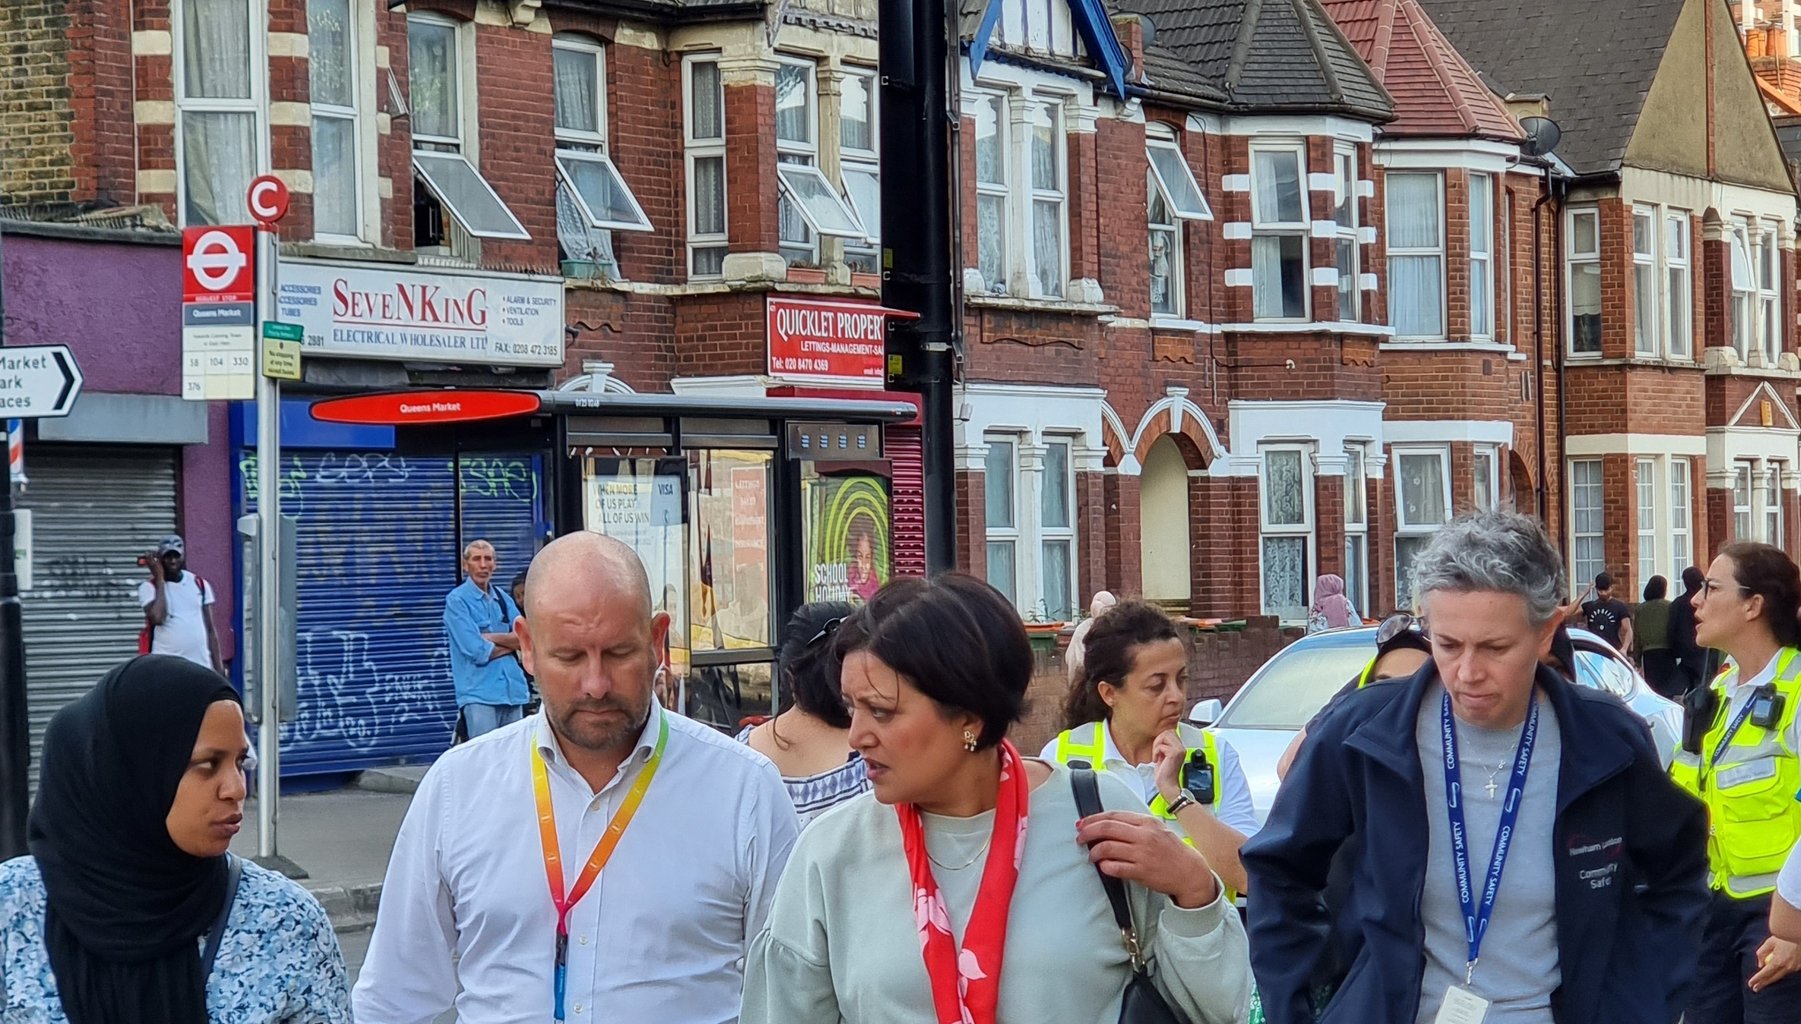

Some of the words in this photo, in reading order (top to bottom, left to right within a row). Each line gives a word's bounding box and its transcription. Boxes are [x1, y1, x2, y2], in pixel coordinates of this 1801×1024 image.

[251, 180, 278, 217] C
[279, 296, 318, 307] CCESSORIES
[507, 295, 526, 305] ALARM
[531, 296, 557, 306] SECURITY
[506, 306, 539, 317] VENTILATION
[506, 316, 524, 327] TOOLS
[776, 308, 835, 342] QUICKLET
[333, 328, 397, 346] ELECTRICAL
[529, 344, 542, 356] 472
[209, 357, 224, 367] 104
[232, 356, 249, 367] 330
[771, 356, 784, 370] Tel:
[784, 357, 797, 371] 020
[797, 358, 813, 371] 8470
[399, 403, 431, 414] Queens
[432, 402, 461, 412] Market
[657, 483, 675, 496] VISA
[606, 498, 618, 510] US
[618, 498, 638, 510] PLAY
[612, 512, 623, 524] OF
[624, 512, 634, 524] US
[814, 562, 849, 585] SCHOOL
[1443, 718, 1455, 770] COMMUNITY
[1516, 745, 1531, 776] SAFETY
[1452, 821, 1465, 850] SAFETY
[1491, 825, 1511, 877] COMMUNITY
[1455, 851, 1470, 904] COMMUNITY
[1484, 876, 1499, 905] SAFETY
